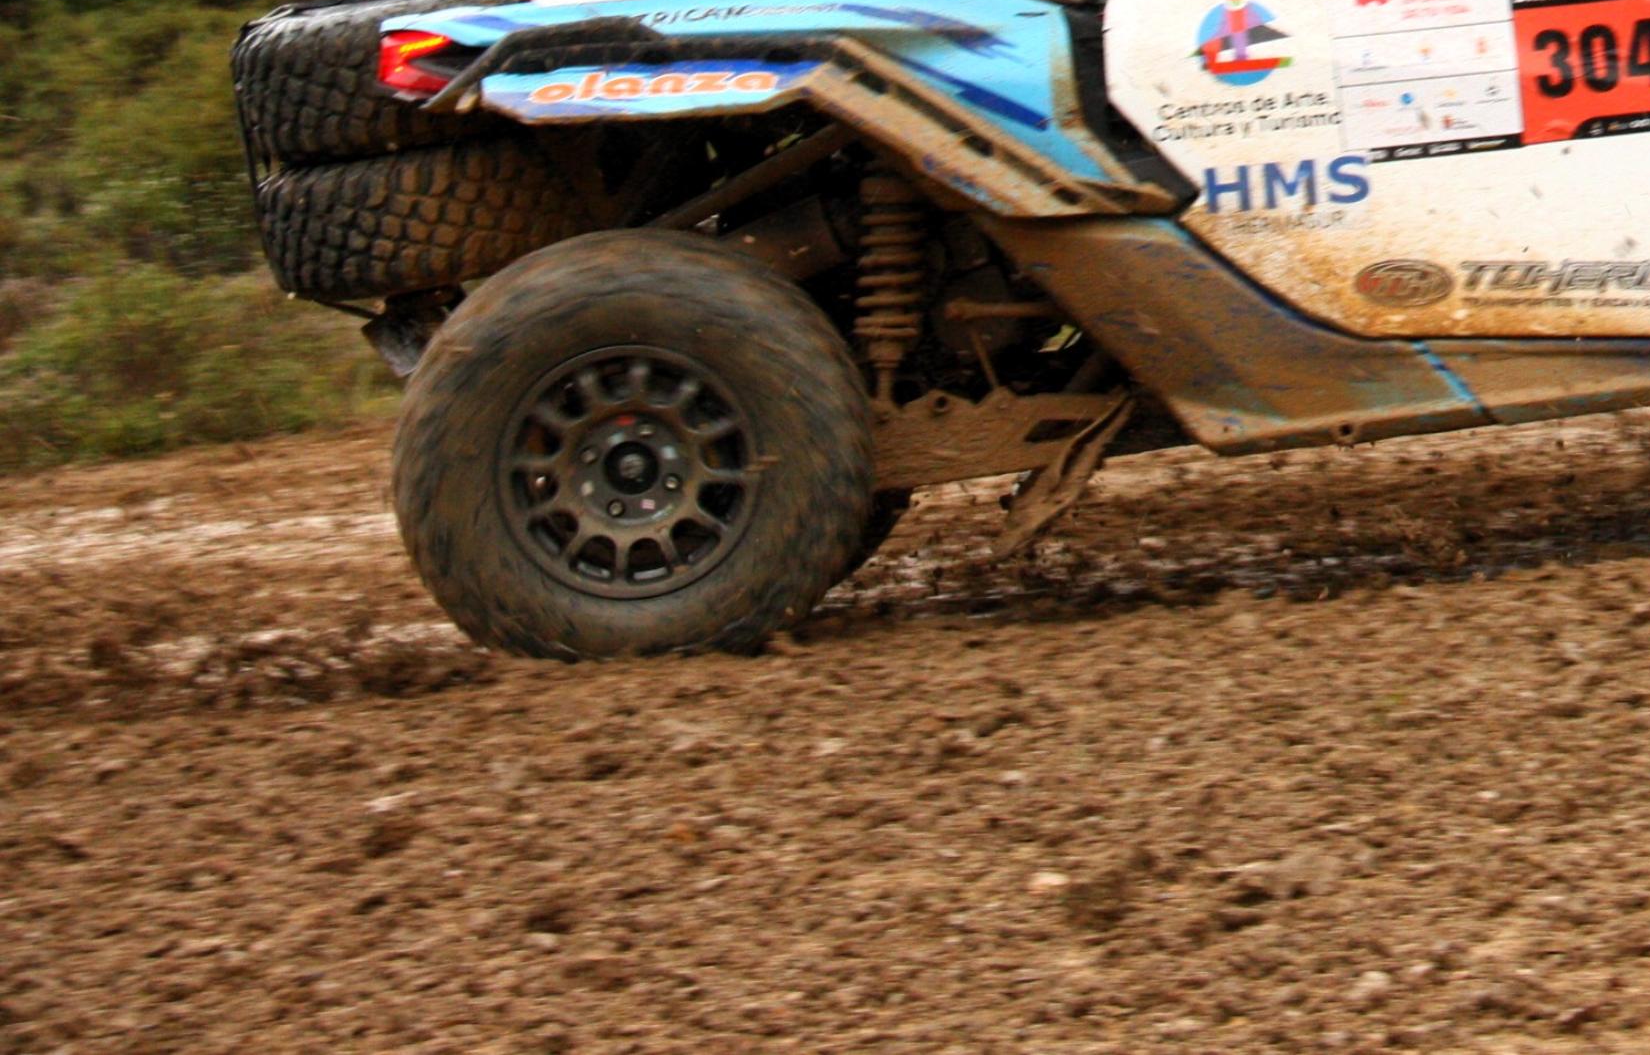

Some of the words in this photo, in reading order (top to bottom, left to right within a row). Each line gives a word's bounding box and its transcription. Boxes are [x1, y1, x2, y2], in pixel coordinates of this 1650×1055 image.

[527, 71, 780, 104] olanza
[1158, 100, 1245, 121] Centros
[1251, 95, 1277, 112] de
[1152, 121, 1235, 142] Cultura
[1203, 155, 1371, 213] HMS
